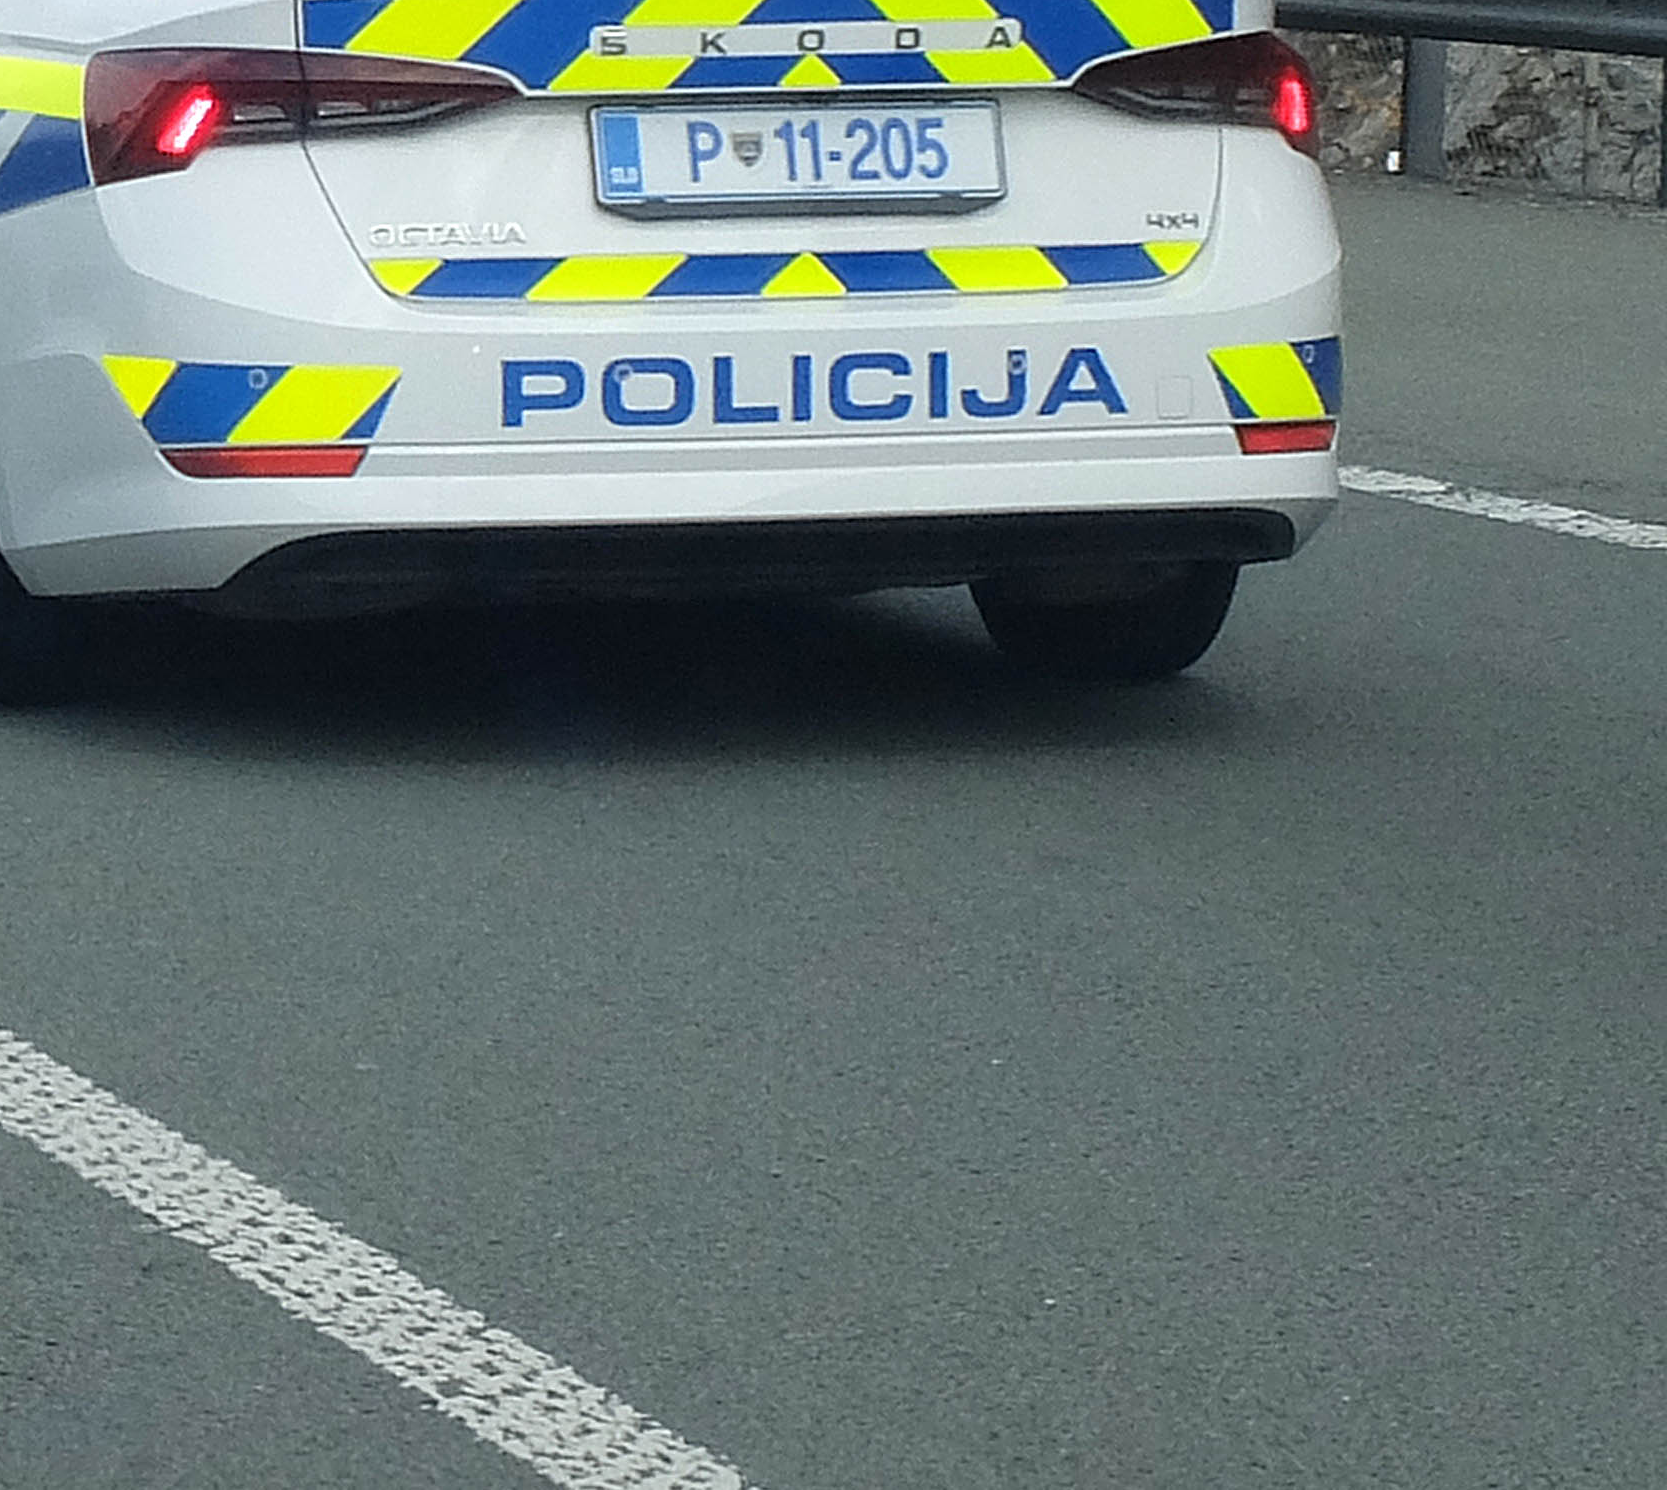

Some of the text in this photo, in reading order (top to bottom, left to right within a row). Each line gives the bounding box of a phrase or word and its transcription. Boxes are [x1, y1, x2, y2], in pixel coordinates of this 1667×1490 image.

[687, 117, 950, 183] P 11-205
[369, 222, 527, 247] OCTAVIA
[500, 347, 1129, 427] POLICIJA
